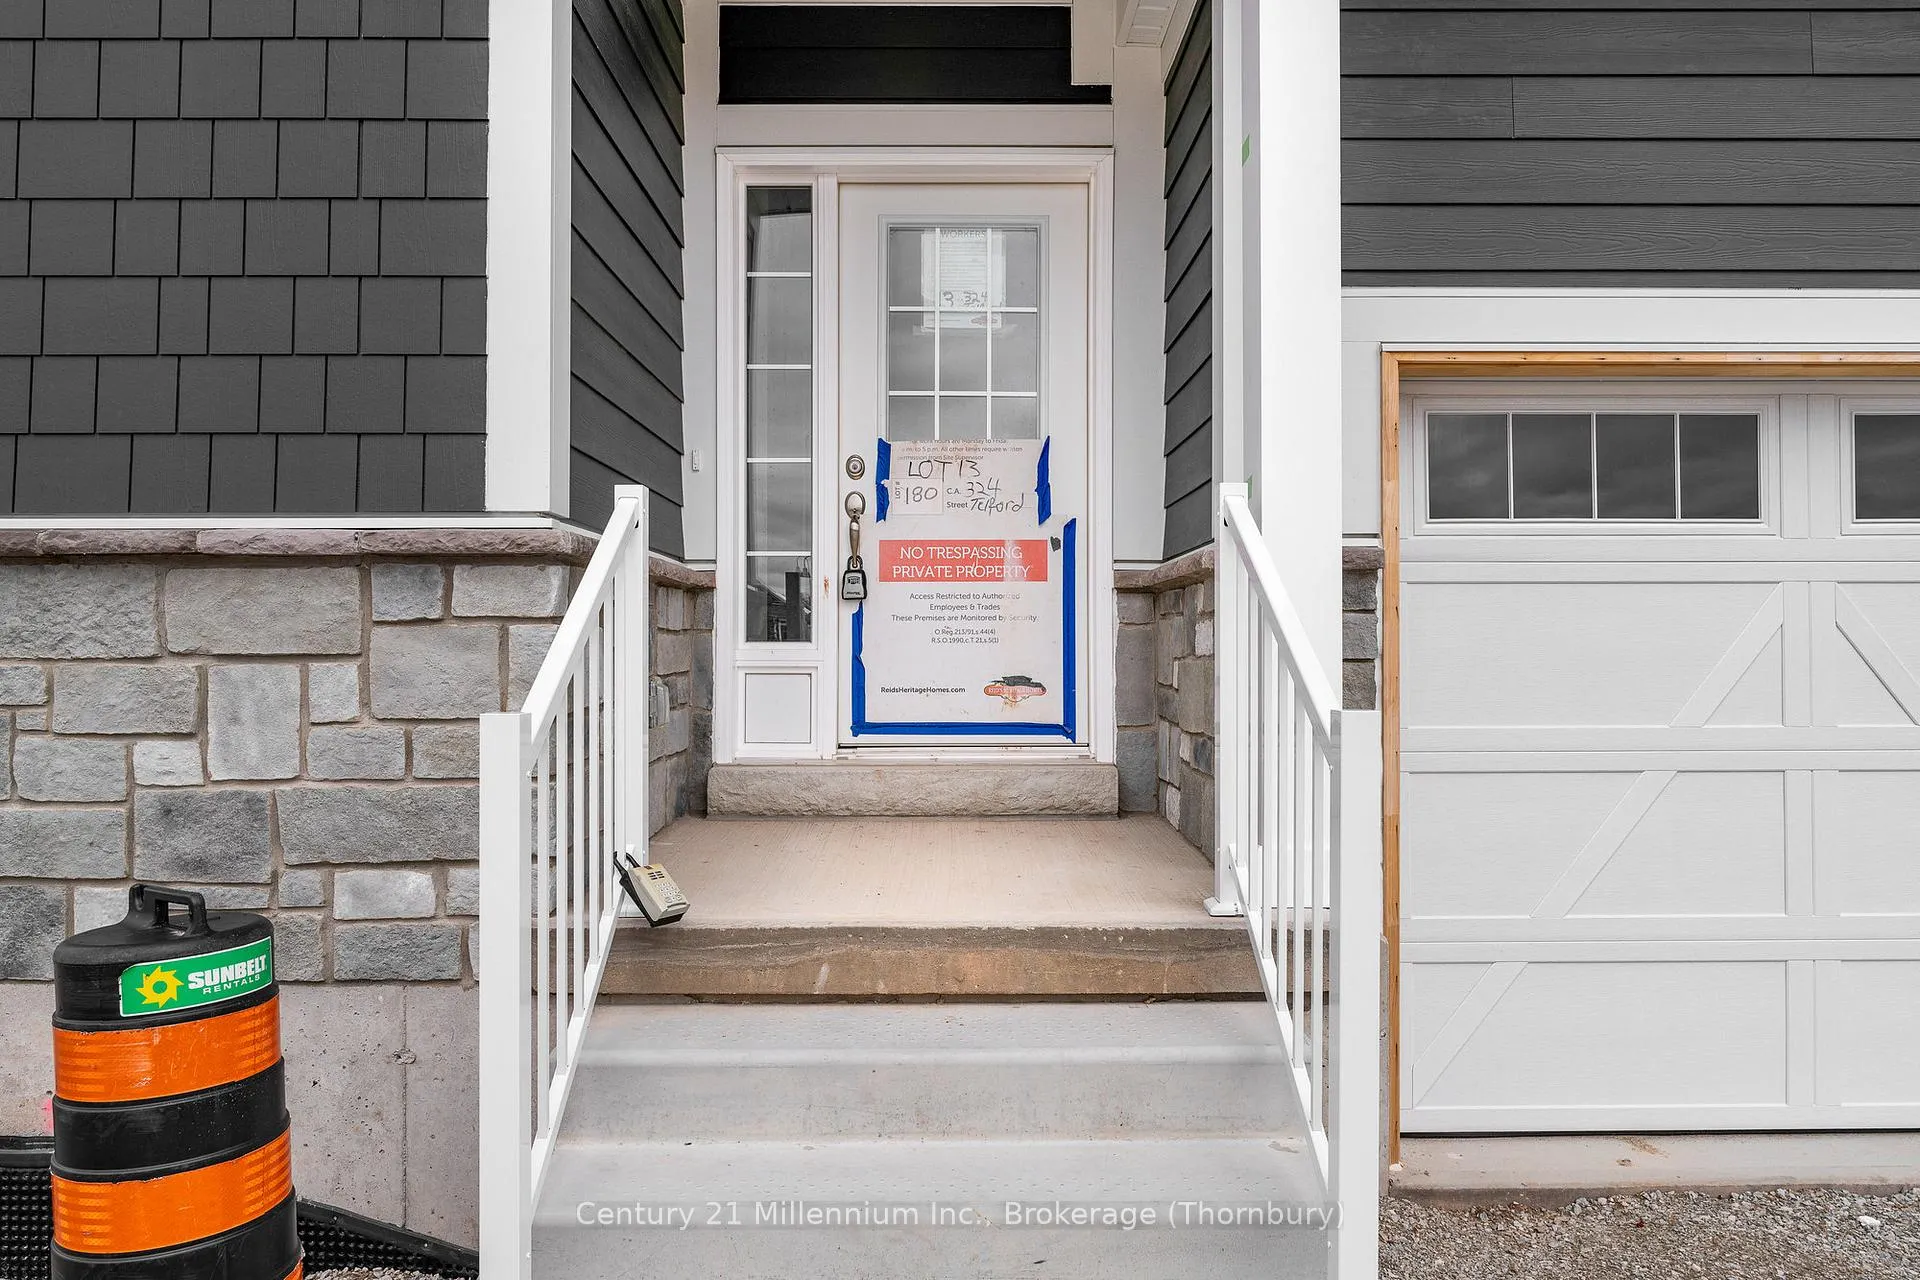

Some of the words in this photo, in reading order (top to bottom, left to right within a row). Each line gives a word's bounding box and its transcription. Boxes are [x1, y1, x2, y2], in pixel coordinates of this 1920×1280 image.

[908, 459, 953, 483] LOT
[959, 459, 981, 478] 13
[964, 477, 1002, 499] 324
[905, 486, 938, 505] 180
[946, 501, 968, 509] Street
[900, 546, 924, 560] NO
[926, 546, 1023, 560] TRESPASSING
[892, 565, 953, 579] PRIVATE
[956, 565, 1032, 579] PROPERTY
[909, 592, 934, 600] Access
[936, 592, 971, 600] Restricted
[972, 592, 980, 600] to
[929, 603, 968, 613] Employees
[969, 603, 976, 611] &
[977, 603, 1001, 611] Trades
[880, 686, 966, 694] ReidsHeritageHomes.com
[187, 954, 266, 990] SUNBELT
[202, 974, 261, 995] RENTALS
